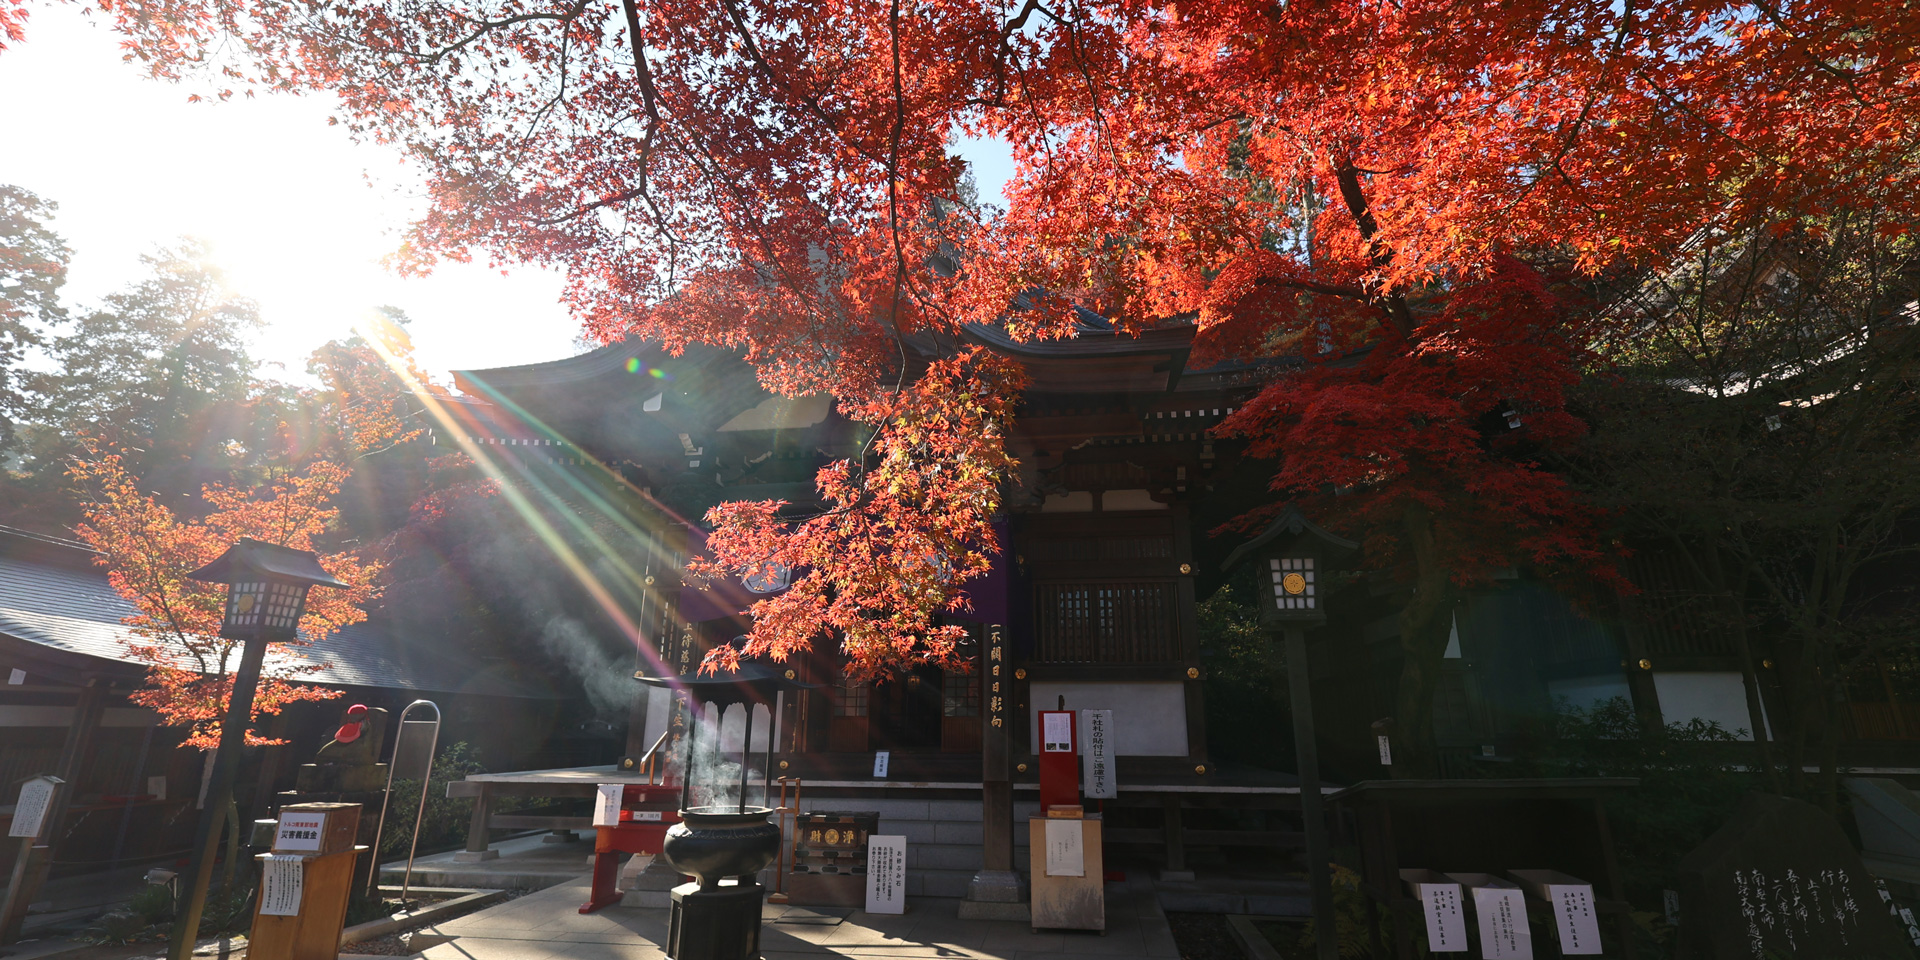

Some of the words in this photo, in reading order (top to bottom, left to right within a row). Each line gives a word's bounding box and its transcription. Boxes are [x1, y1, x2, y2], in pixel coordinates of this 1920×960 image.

[1092, 713, 1105, 794] 千社札の貼付はご遠慮下さい
[281, 830, 317, 839] 災害義援金
